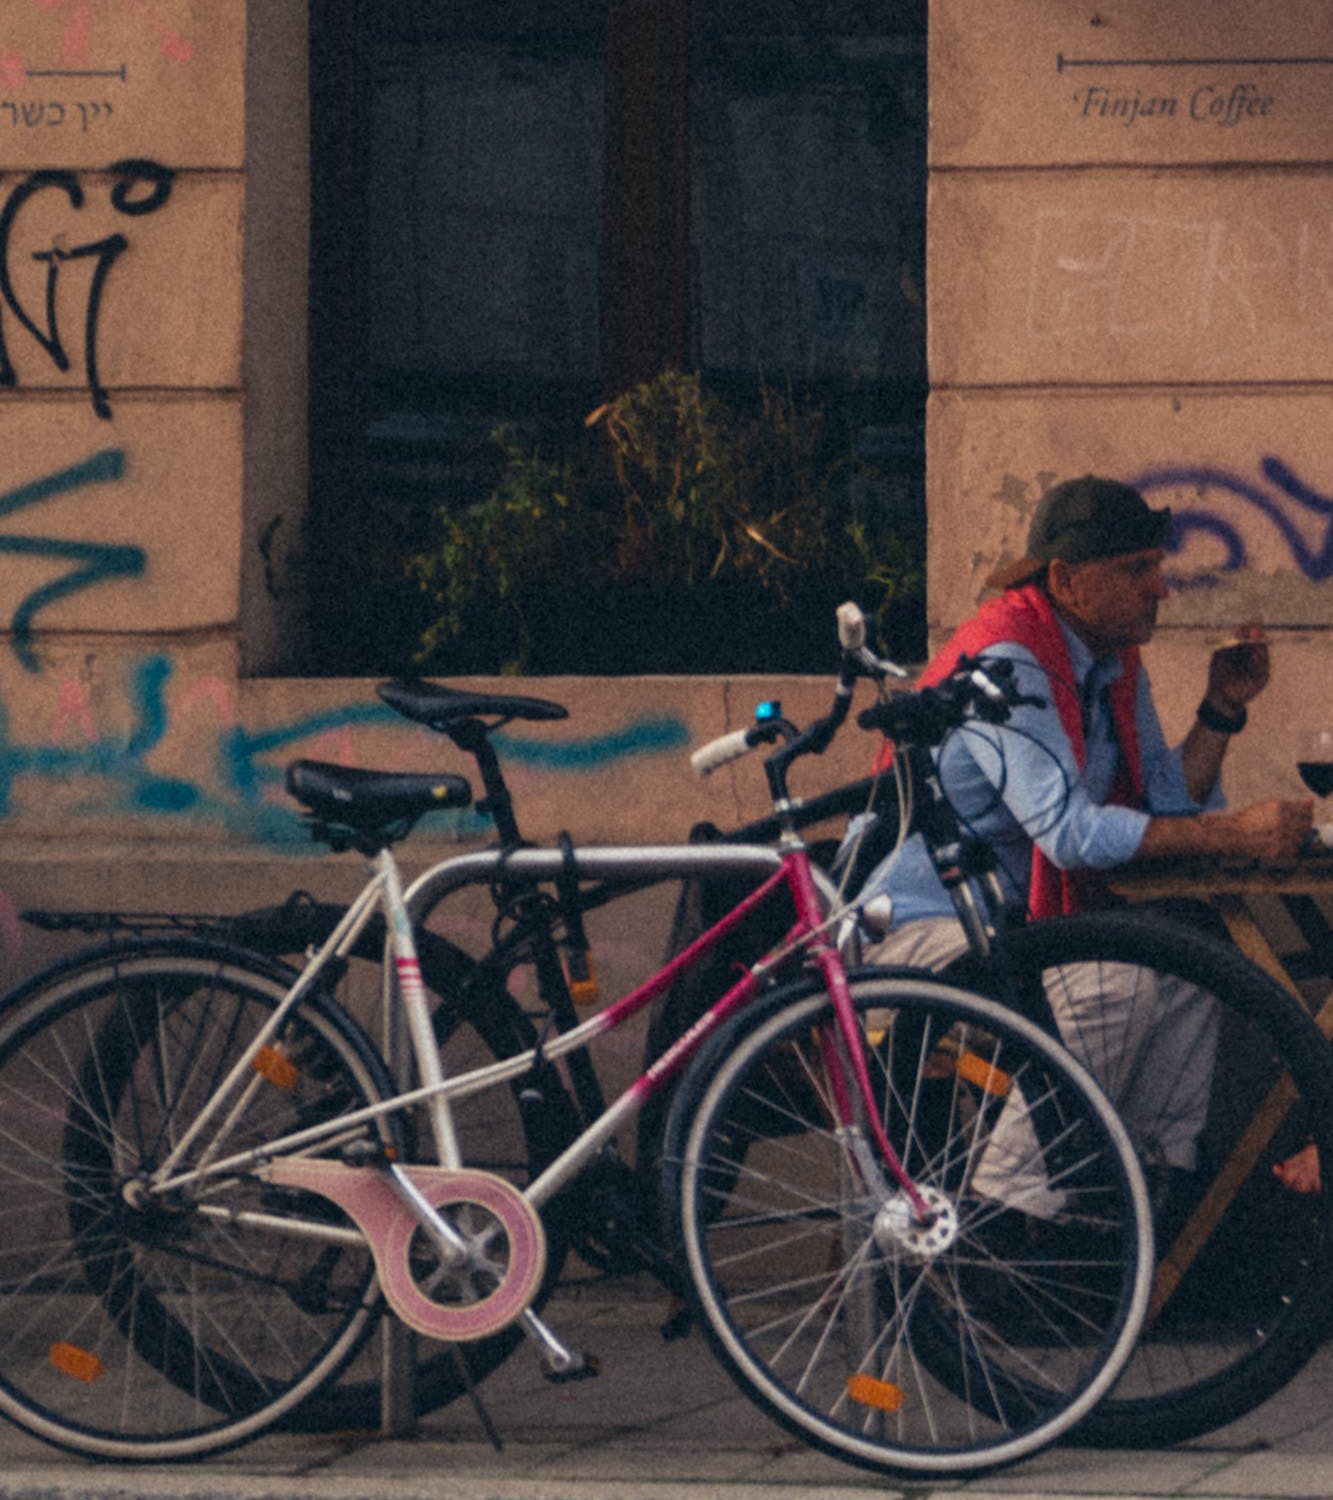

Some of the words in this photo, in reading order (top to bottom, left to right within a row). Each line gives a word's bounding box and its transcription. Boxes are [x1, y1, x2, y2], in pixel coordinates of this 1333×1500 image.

[1, 102, 66, 127] כשר
[75, 101, 114, 133] יין
[1073, 86, 1178, 127] Finjan
[1189, 84, 1275, 127] Coffee
